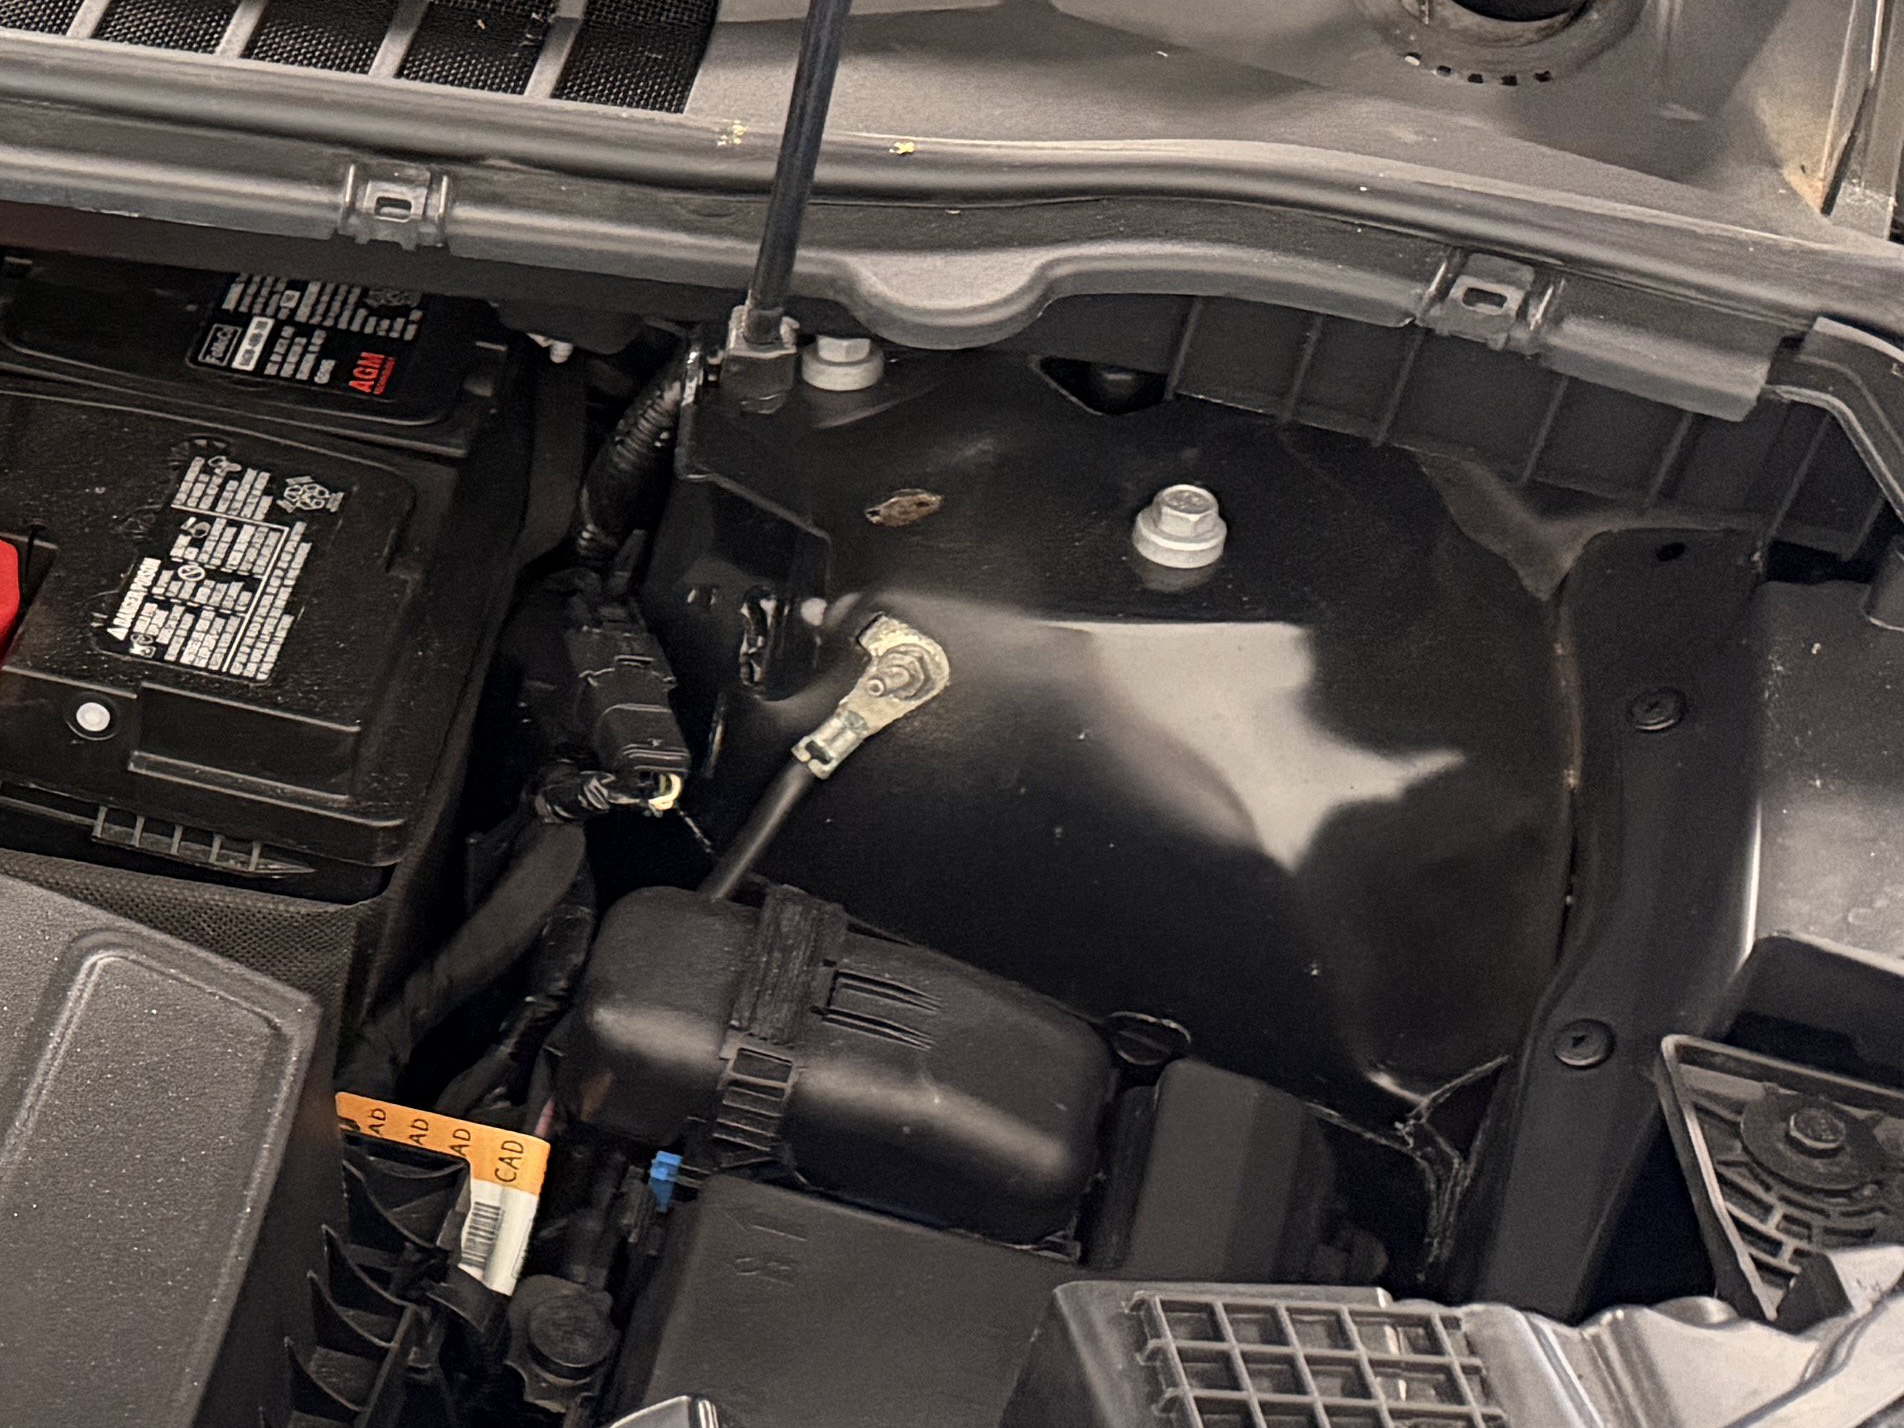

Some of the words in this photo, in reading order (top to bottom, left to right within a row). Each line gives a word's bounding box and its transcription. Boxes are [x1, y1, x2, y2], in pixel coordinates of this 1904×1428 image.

[349, 351, 385, 394] AGM
[369, 1108, 387, 1136] AD
[409, 1118, 429, 1146] AD
[450, 1128, 472, 1157] AD
[495, 1139, 524, 1183] CAD
